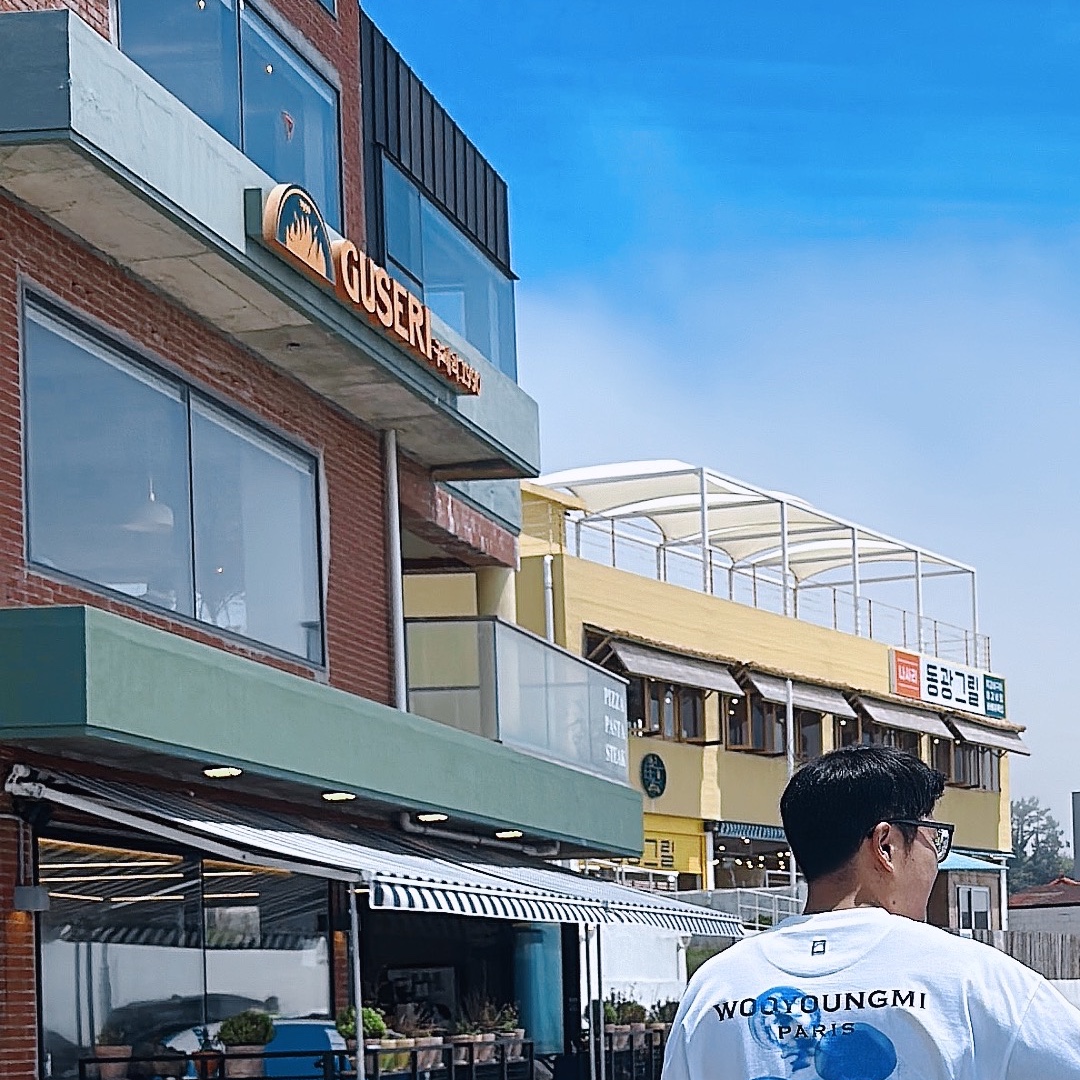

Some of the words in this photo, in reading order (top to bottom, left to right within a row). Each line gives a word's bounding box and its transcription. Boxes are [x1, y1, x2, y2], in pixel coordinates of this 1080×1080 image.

[338, 239, 433, 361] GUSERI
[926, 663, 979, 708] 동광그릴
[603, 686, 625, 713] PIZZA
[604, 715, 626, 740] PASTA
[605, 743, 626, 767] STEAK
[713, 989, 926, 1022] WOOYOUNGMI
[778, 1022, 856, 1040] PARIS
